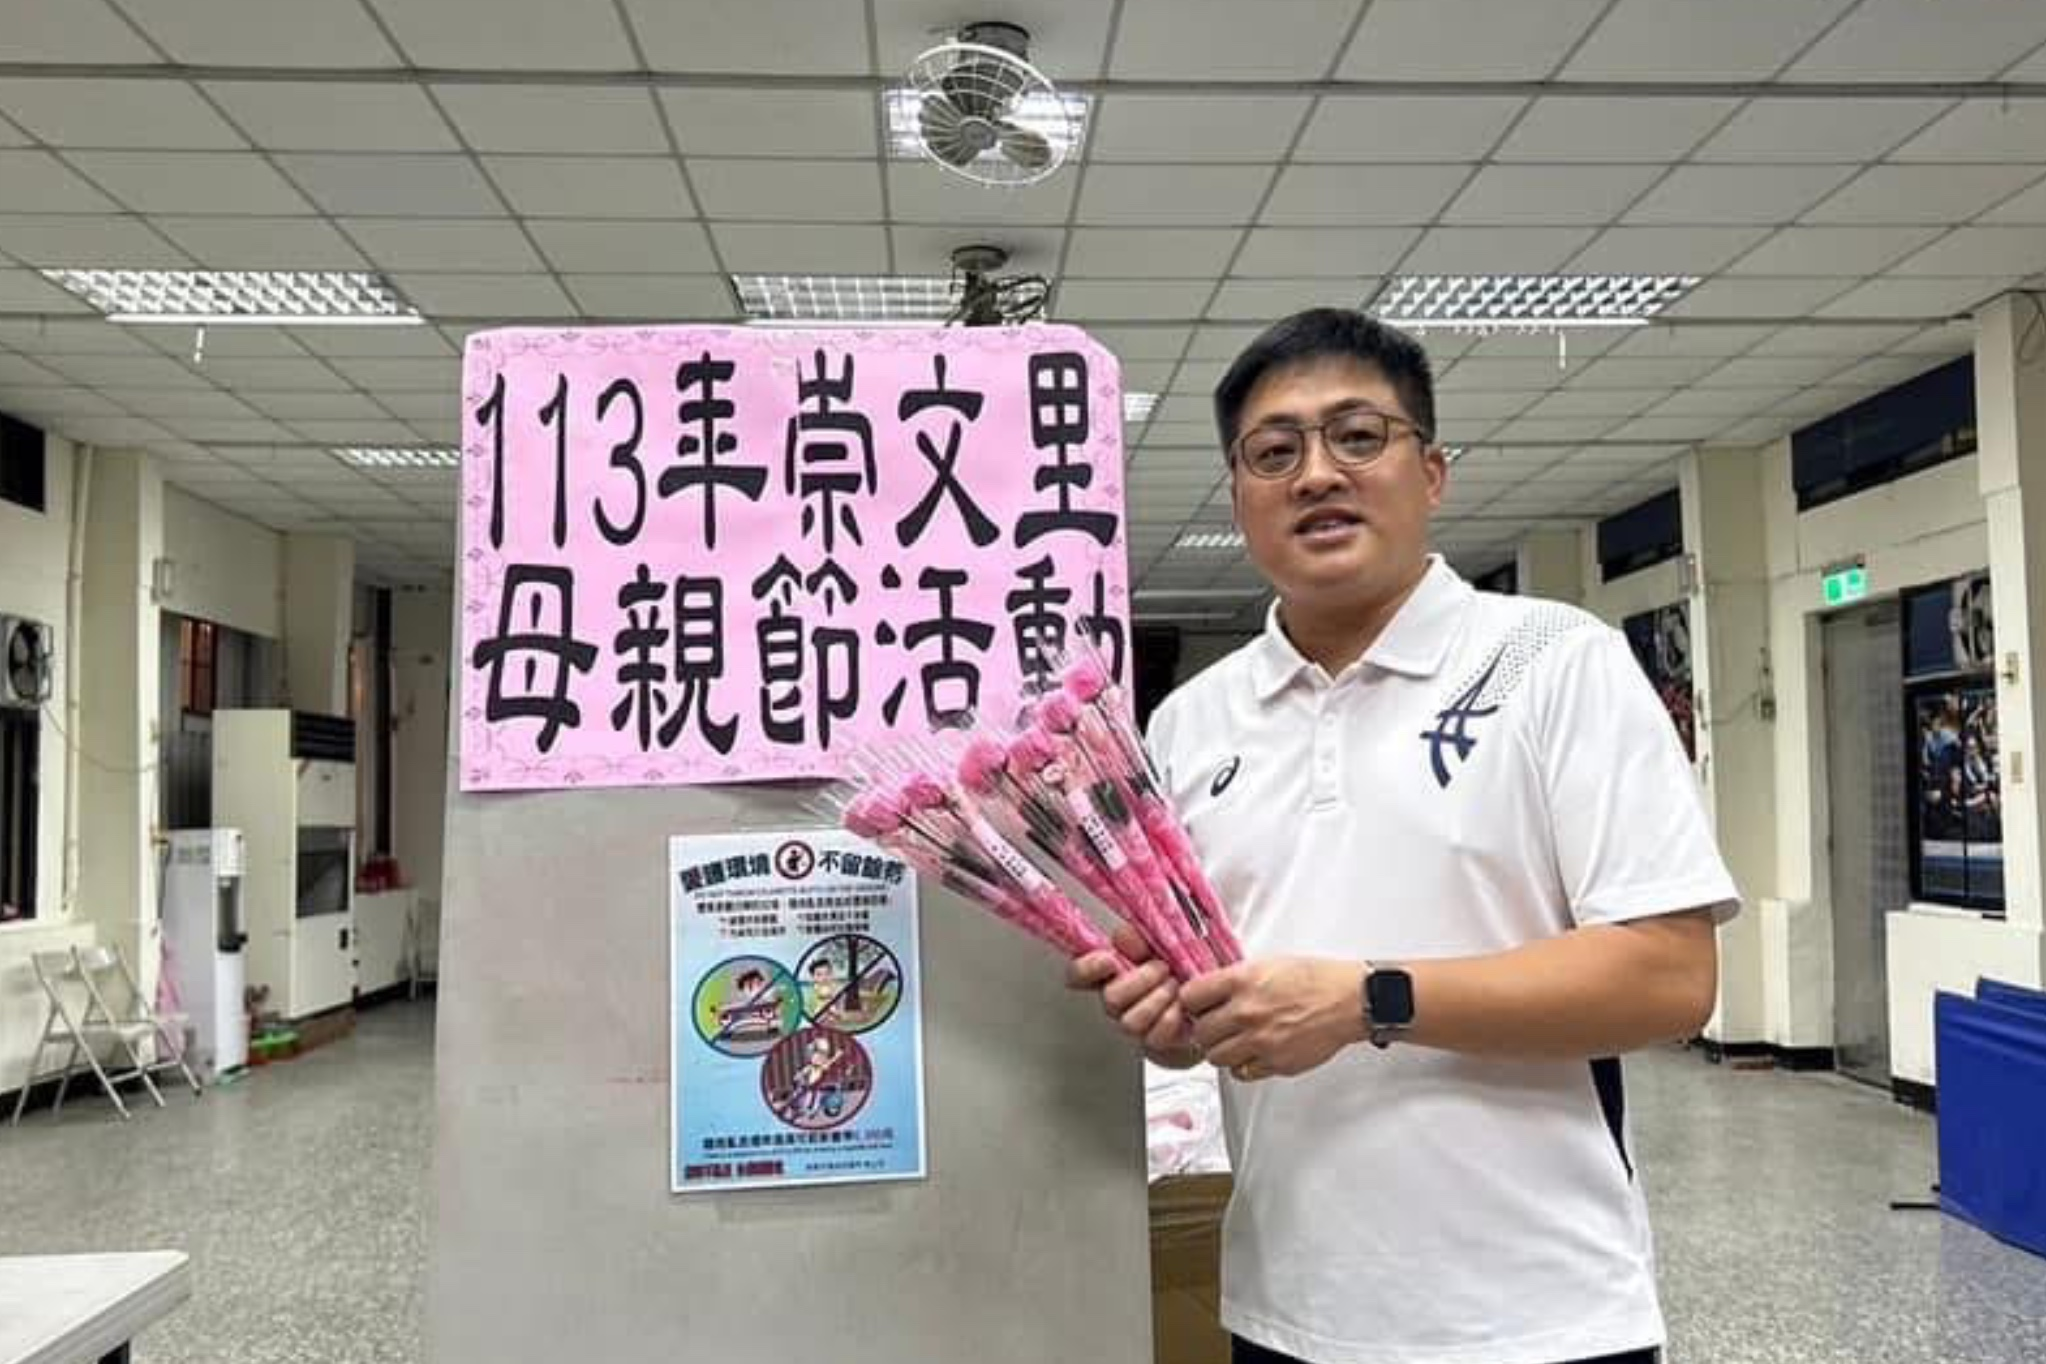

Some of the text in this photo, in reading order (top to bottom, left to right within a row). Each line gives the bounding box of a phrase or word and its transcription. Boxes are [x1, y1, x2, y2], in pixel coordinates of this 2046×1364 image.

[475, 350, 1118, 553] 113年崇文里
[472, 554, 1124, 754] 母親節活動
